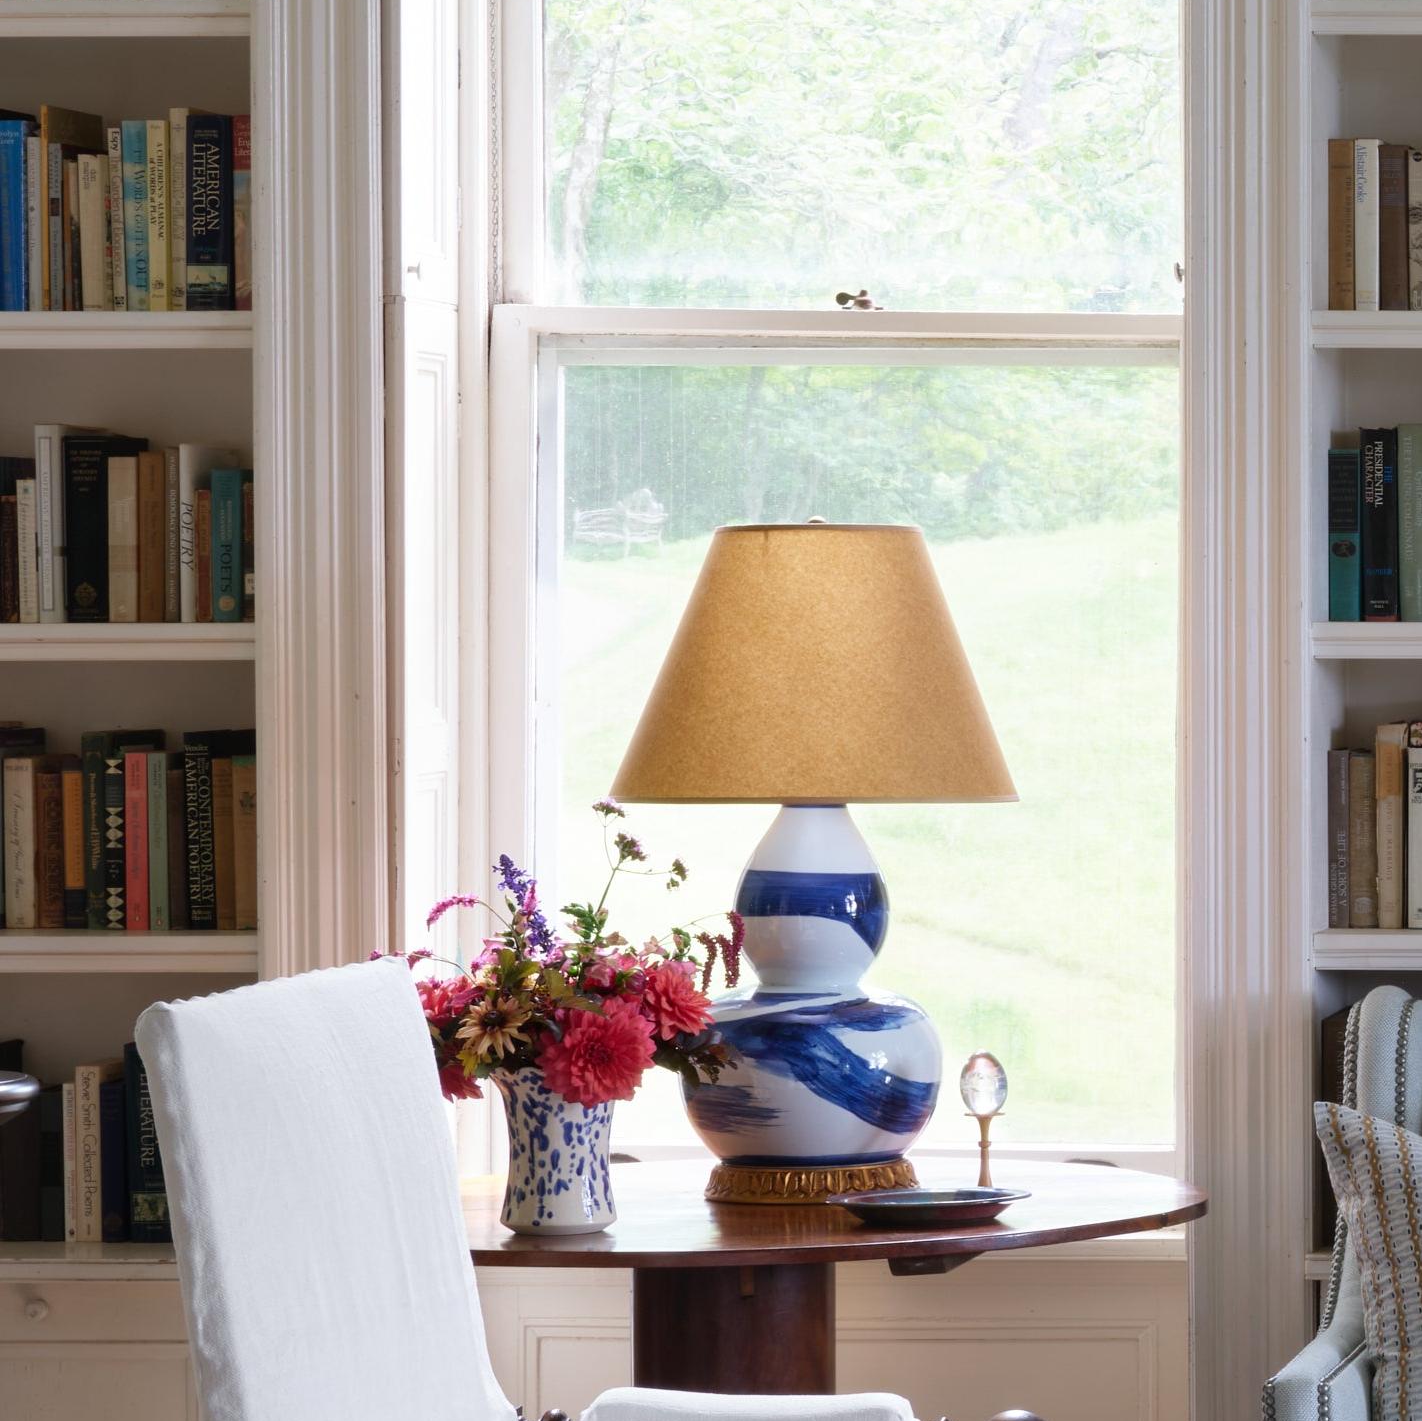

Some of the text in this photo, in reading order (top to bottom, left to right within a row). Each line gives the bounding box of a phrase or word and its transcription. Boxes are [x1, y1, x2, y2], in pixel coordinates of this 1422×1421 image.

[110, 130, 120, 151] Espy
[192, 143, 206, 238] LITERATURE
[206, 143, 220, 231] AMERICAN
[1364, 444, 1375, 504] CHARACTER
[1374, 441, 1384, 508] PRESIDENTIAL
[180, 502, 194, 571] POETRY
[220, 544, 233, 593] POETS
[184, 757, 202, 903] AMERICAN POETRY
[197, 774, 215, 903] CONTEMPORARY
[1337, 830, 1347, 907] A SORT OF LIFE
[81, 1071, 97, 1217] Stevie Smith Collected Poems
